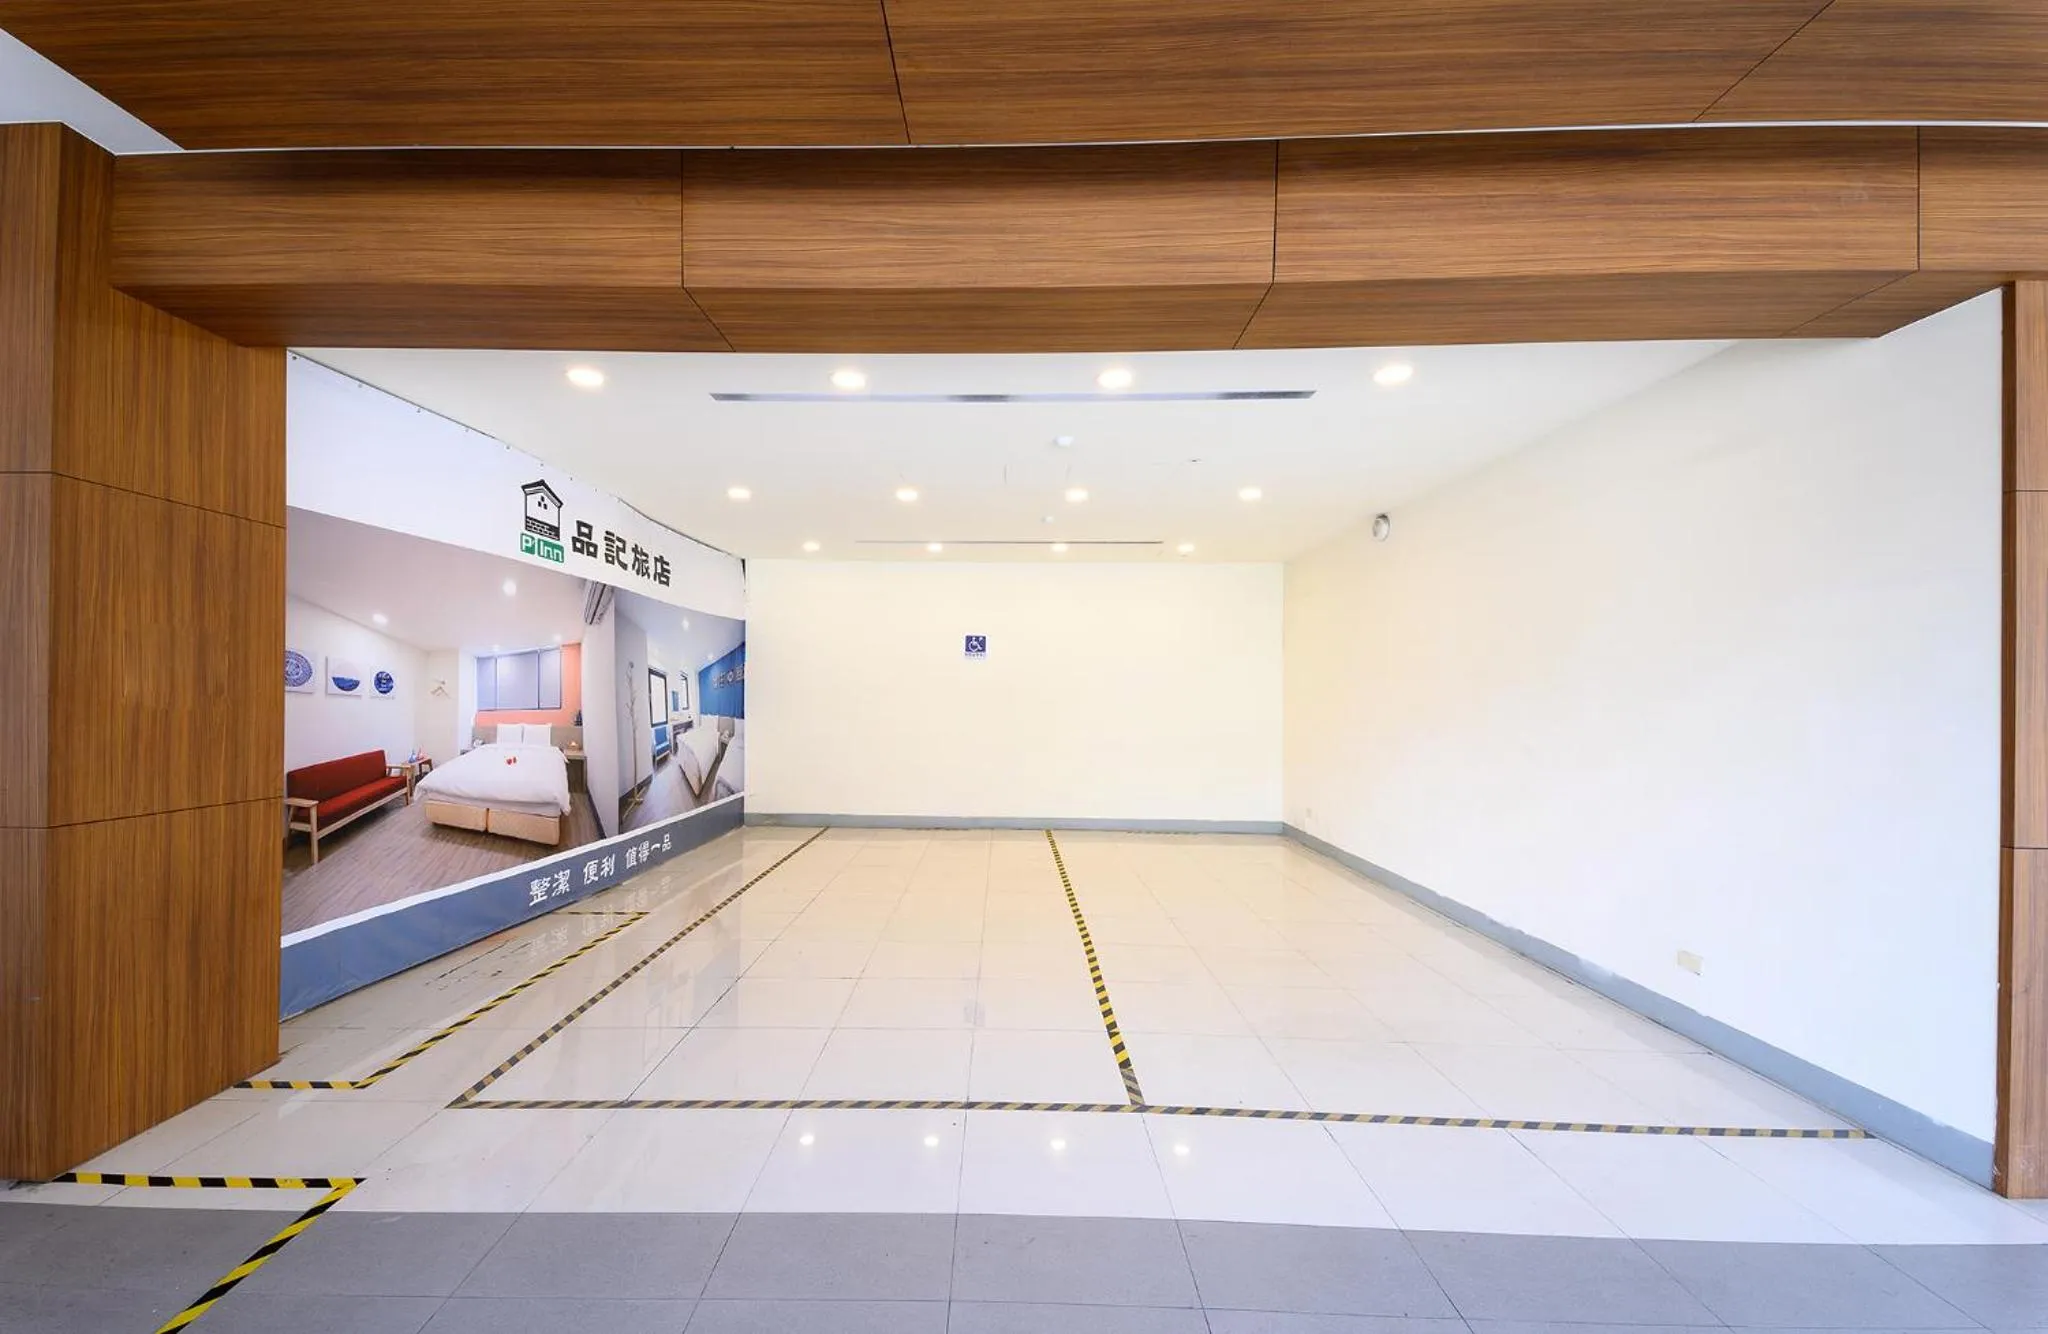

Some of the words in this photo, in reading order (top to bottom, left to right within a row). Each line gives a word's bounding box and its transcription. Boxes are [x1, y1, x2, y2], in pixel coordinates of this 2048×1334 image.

[540, 541, 563, 562] Inn
[571, 520, 671, 587] 品記旅店
[529, 869, 571, 906] 整潔
[583, 855, 616, 885] 便利
[625, 833, 672, 868] 值得一品
